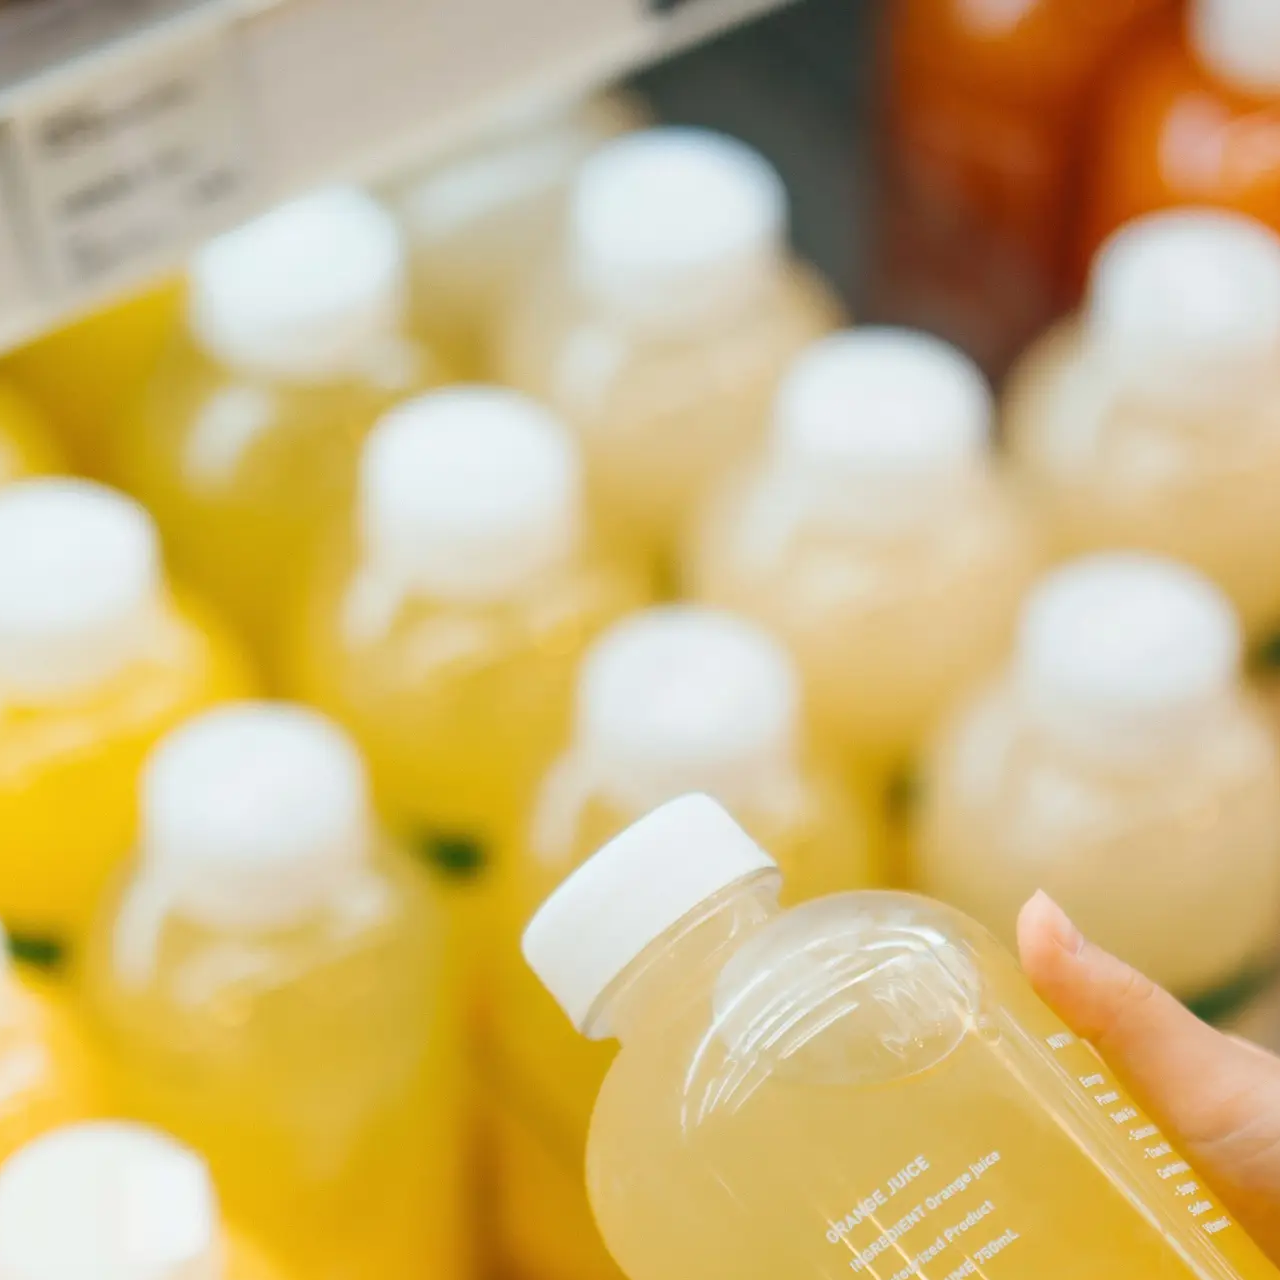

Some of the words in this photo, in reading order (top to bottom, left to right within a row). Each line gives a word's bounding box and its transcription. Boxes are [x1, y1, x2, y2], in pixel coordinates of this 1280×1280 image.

[825, 1188, 888, 1244] ORANGE
[887, 1154, 930, 1196] JUICE
[849, 1203, 926, 1273] INGREDIENT
[925, 1172, 971, 1211] Orange
[969, 1150, 1001, 1180] juice
[944, 1199, 996, 1243] Product
[973, 1228, 1020, 1265] 750mL
